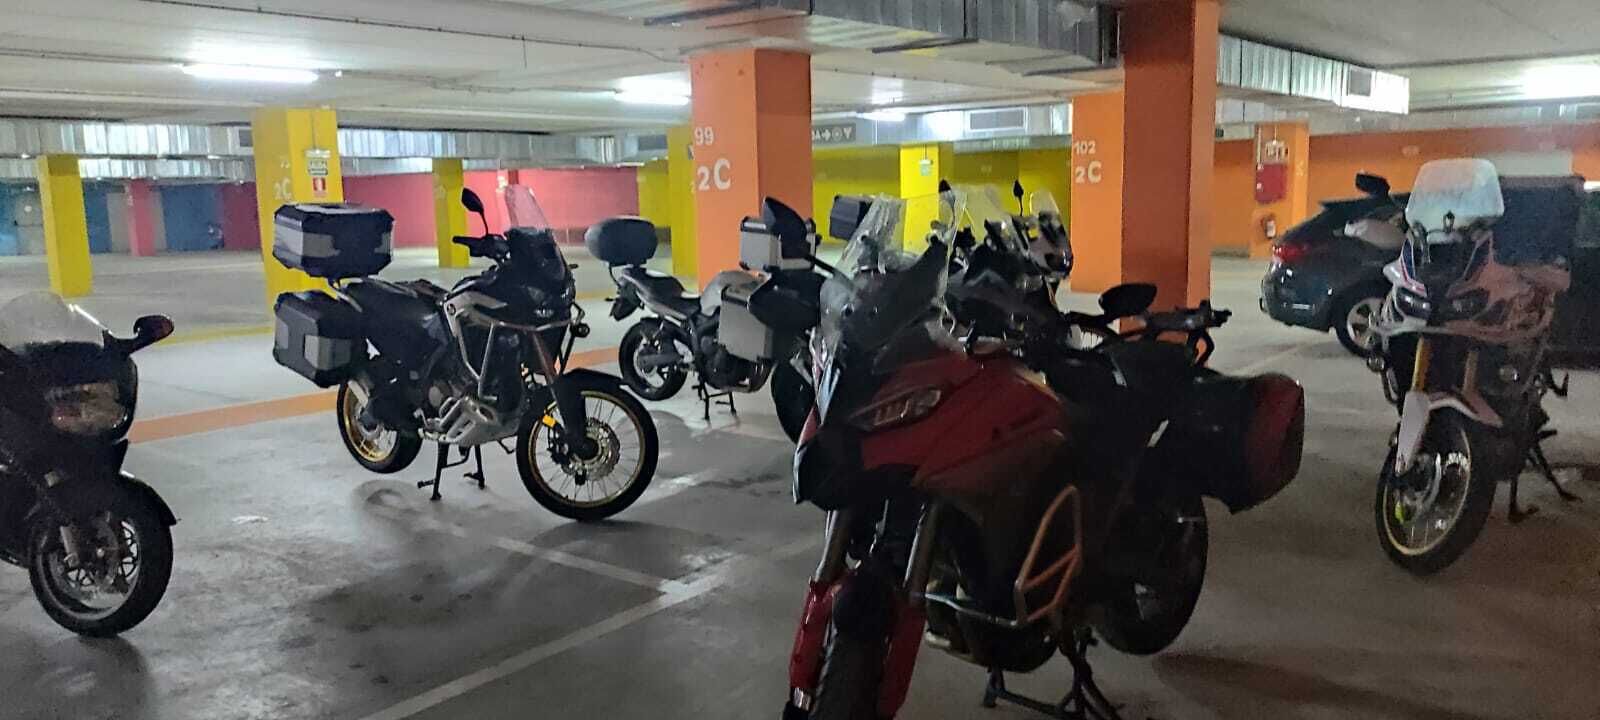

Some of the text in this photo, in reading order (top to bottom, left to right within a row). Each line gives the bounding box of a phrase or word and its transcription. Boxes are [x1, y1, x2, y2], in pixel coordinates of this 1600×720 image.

[694, 126, 714, 146] 99
[1073, 140, 1096, 155] 102
[697, 159, 730, 190] 2C
[1074, 160, 1102, 184] 2C
